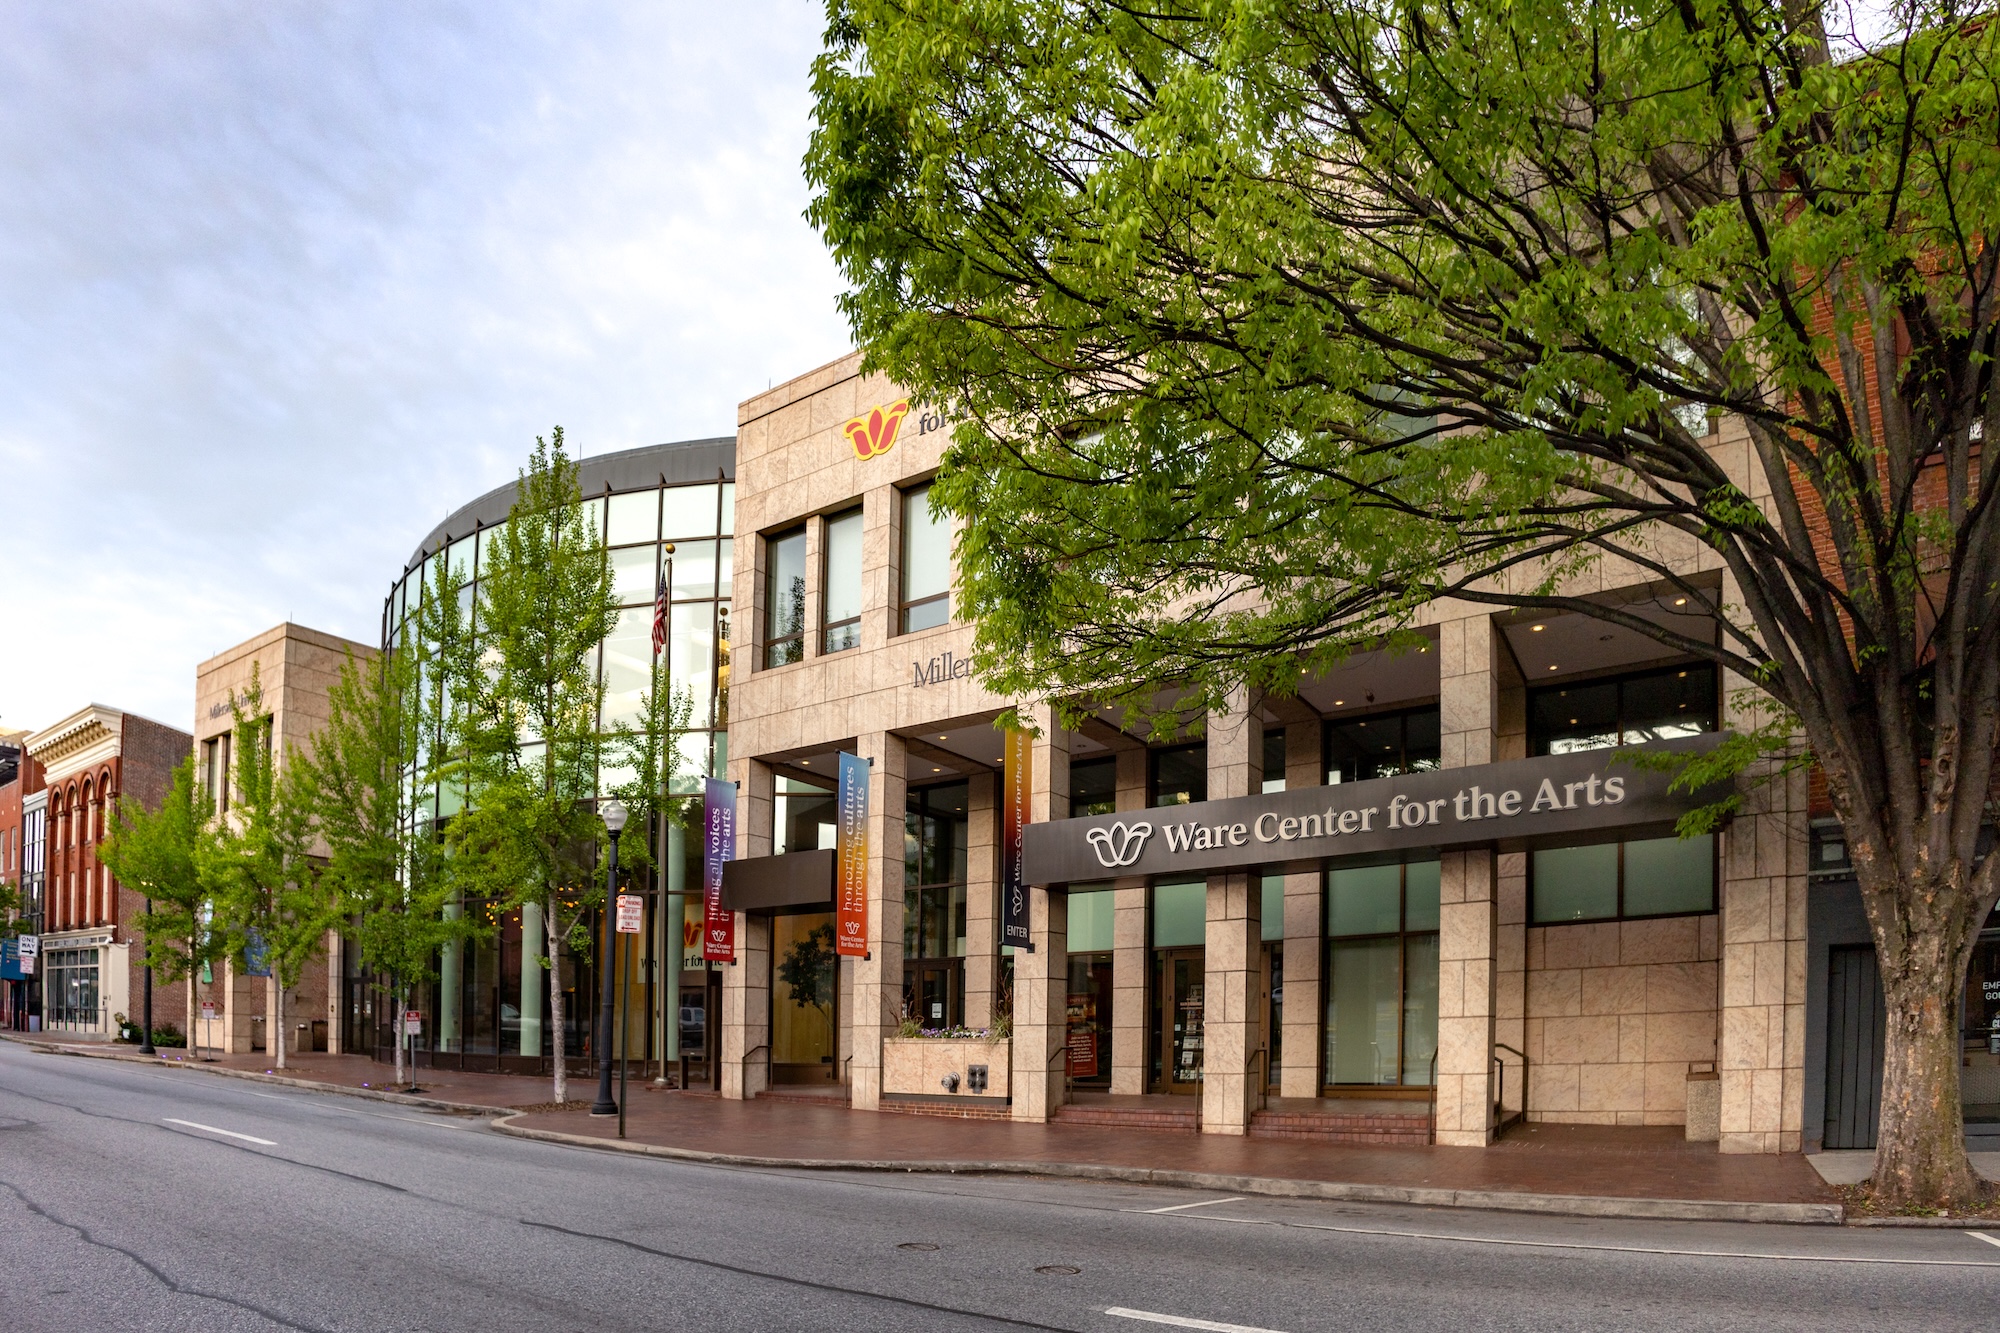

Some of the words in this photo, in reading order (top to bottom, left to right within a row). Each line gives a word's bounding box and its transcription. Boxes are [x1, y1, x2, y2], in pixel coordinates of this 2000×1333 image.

[919, 412, 947, 436] for
[913, 651, 974, 688] Miller
[1015, 735, 1023, 762] Arts
[844, 766, 855, 835] cultures
[855, 786, 865, 819] arts
[1162, 821, 1248, 852] Ware
[1254, 806, 1379, 843] Center
[1388, 794, 1447, 830] for
[1453, 785, 1522, 822] the
[1529, 773, 1626, 813] Arts
[709, 807, 720, 855] voices
[721, 807, 731, 837] arts
[854, 821, 864, 847] the
[1014, 804, 1023, 848] Center
[709, 857, 719, 875] all
[720, 840, 731, 862] the
[843, 837, 855, 911] honoring
[853, 851, 865, 913] through
[709, 878, 722, 921] lifting
[1006, 925, 1028, 939] ENTER
